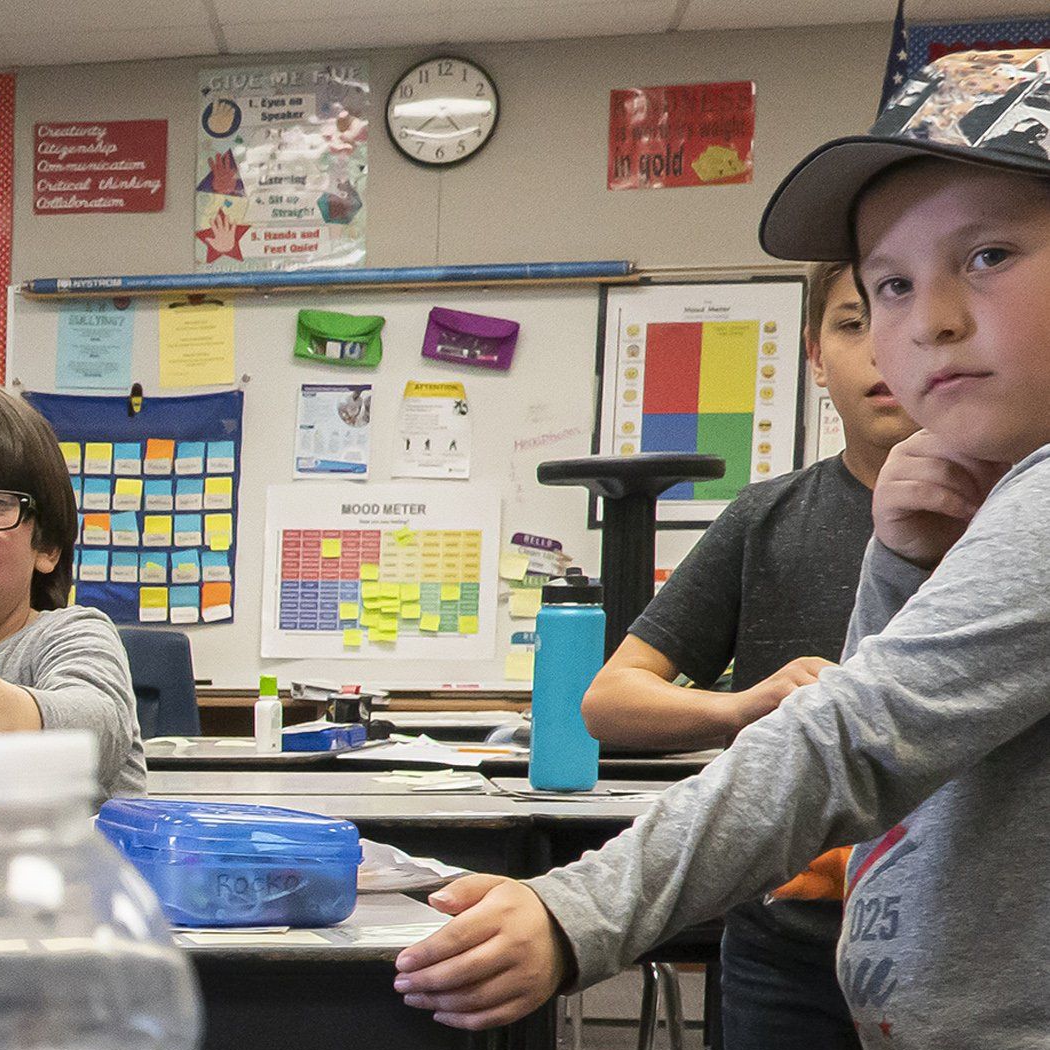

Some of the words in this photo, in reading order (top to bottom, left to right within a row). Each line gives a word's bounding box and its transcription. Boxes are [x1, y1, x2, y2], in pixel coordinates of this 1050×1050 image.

[418, 69, 429, 83] 11
[437, 62, 453, 76] 12
[462, 68, 467, 82] 1
[399, 84, 413, 98] 10
[475, 82, 485, 97] 2
[261, 97, 286, 109] Eyes
[260, 110, 305, 122] Speaker
[38, 125, 107, 141] Creativity
[37, 140, 118, 160] Citizenship
[416, 140, 426, 154] 7
[435, 146, 445, 159] 6
[456, 140, 466, 154] 5
[639, 145, 685, 183] gold
[37, 177, 91, 192] Critical
[98, 176, 162, 194] thinking
[264, 230, 297, 241] Hands
[301, 229, 320, 239] and
[263, 244, 287, 254] Feet
[290, 243, 319, 254] Quiet
[71, 276, 122, 289] NYSTROM
[341, 503, 380, 515] MOOD
[383, 503, 426, 515] METER
[523, 534, 553, 548] HELLO
